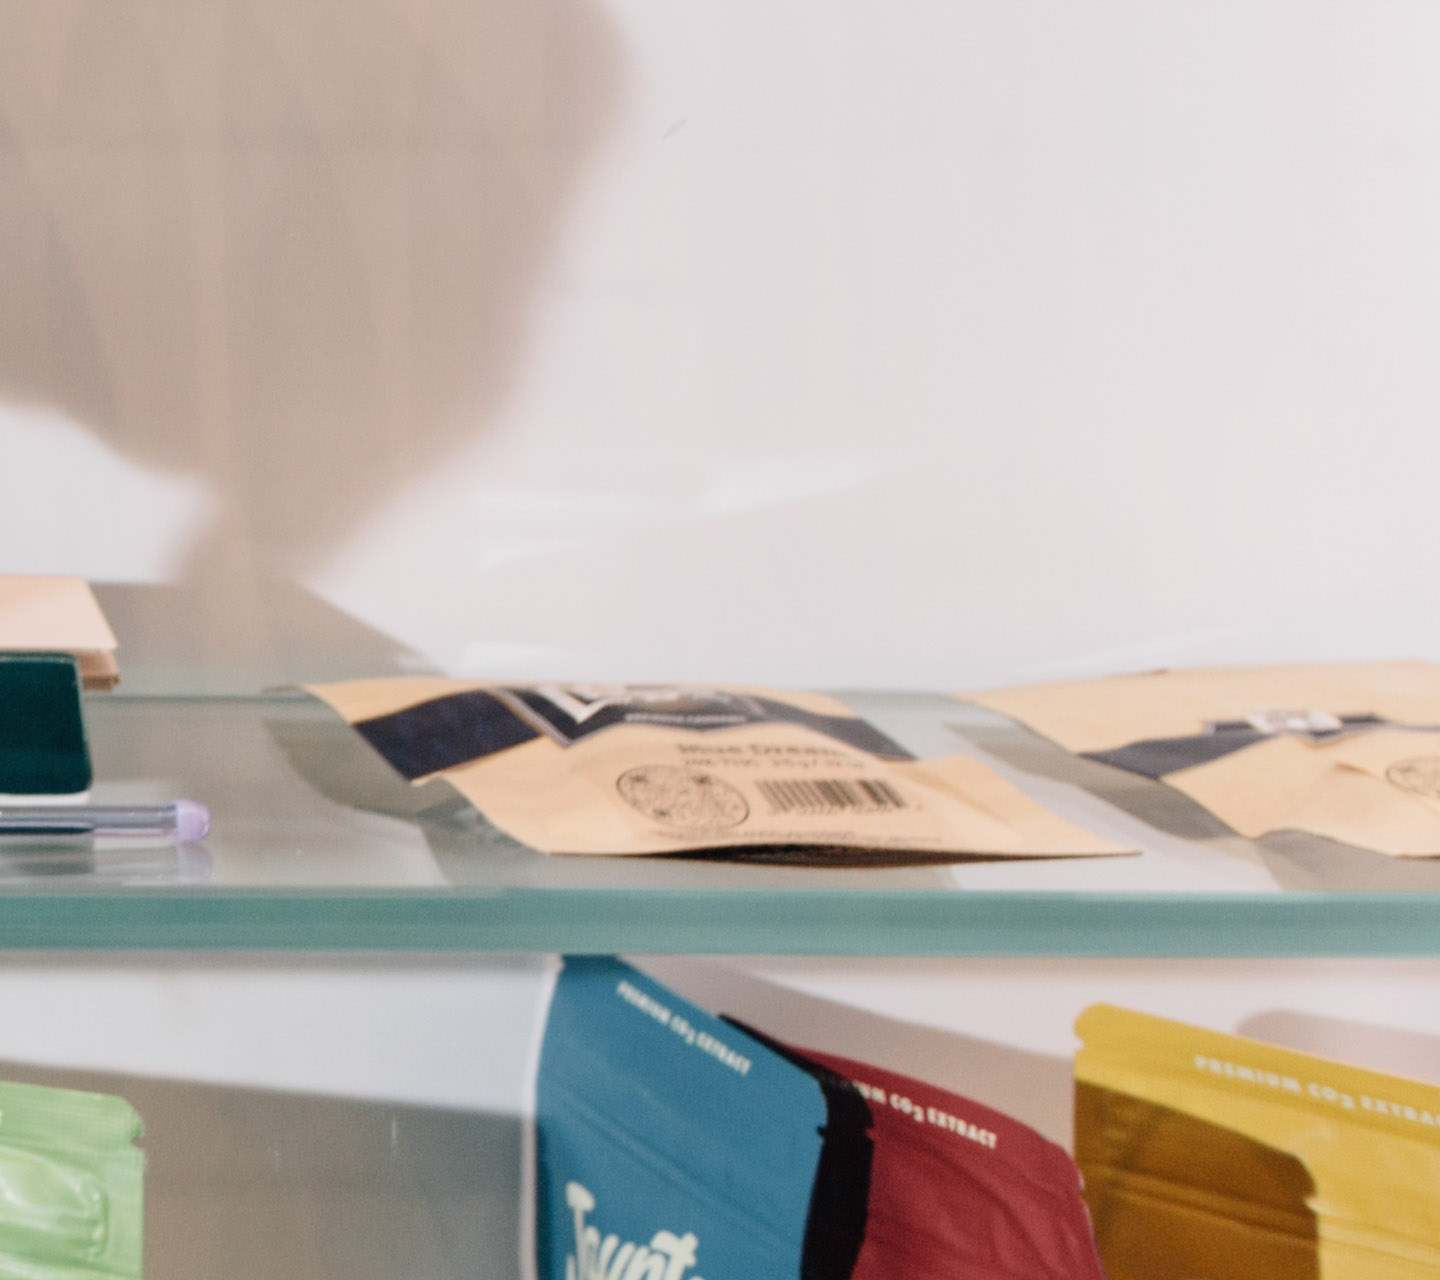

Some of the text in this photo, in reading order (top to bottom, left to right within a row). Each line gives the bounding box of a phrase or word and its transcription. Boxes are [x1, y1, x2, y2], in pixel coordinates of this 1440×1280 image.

[1192, 1053, 1303, 1097] PREMIUM
[1358, 1094, 1440, 1129] EXTRA
[926, 1106, 999, 1150] EXTRACT
